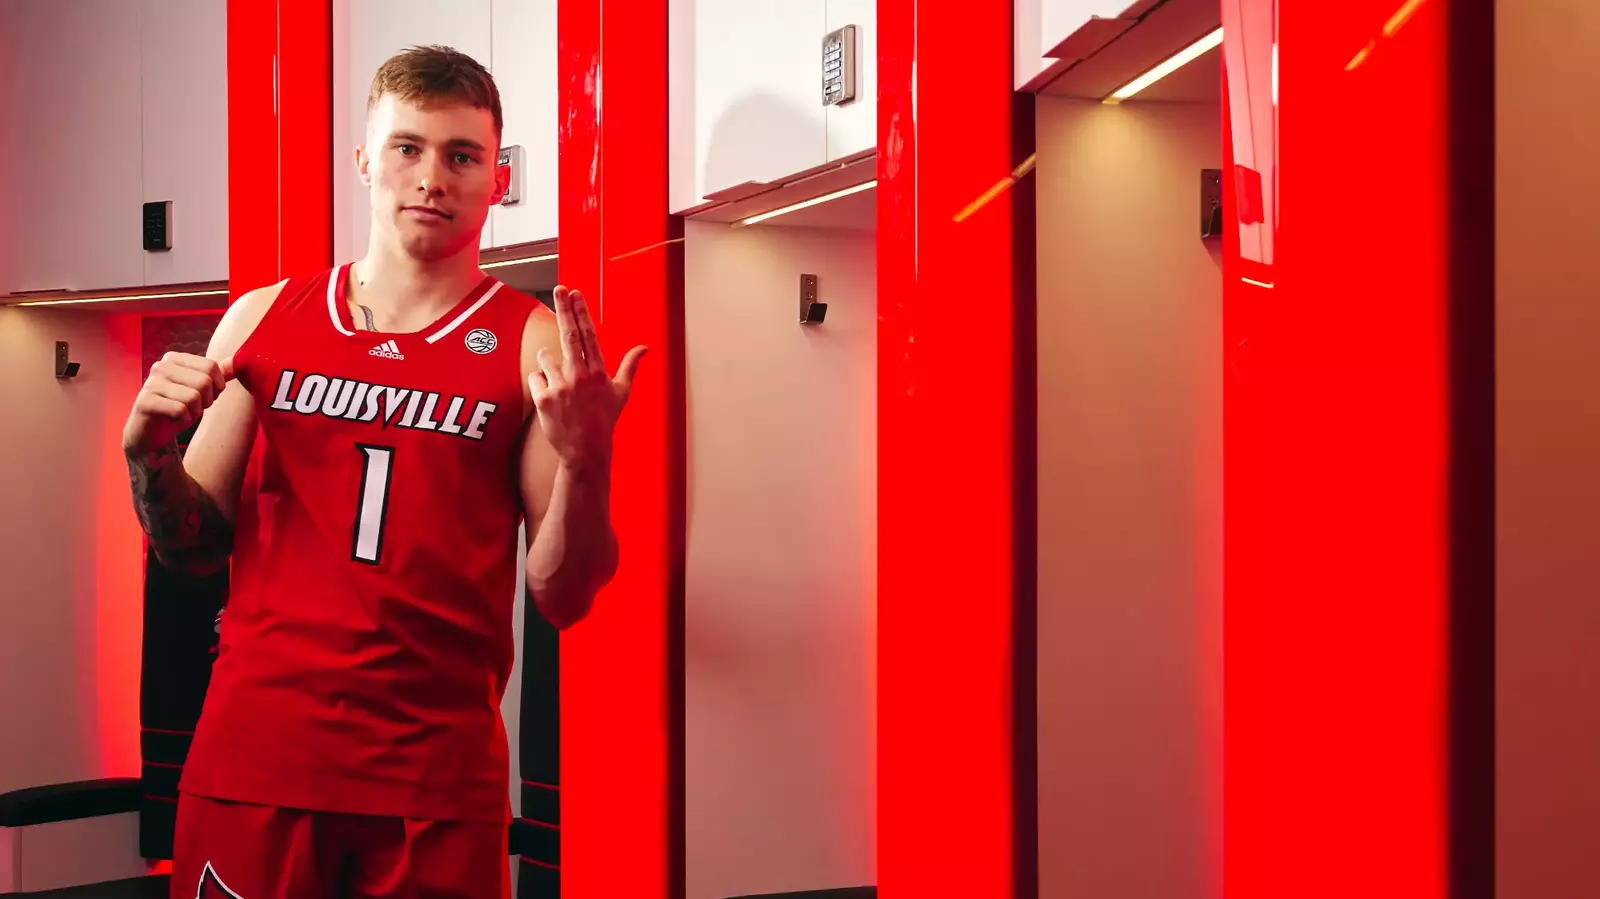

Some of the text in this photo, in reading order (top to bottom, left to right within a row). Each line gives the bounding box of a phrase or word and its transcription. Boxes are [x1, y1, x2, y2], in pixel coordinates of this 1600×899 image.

[368, 349, 405, 361] adidas
[270, 369, 498, 440] LOUISVILLE
[352, 442, 395, 565] 1
